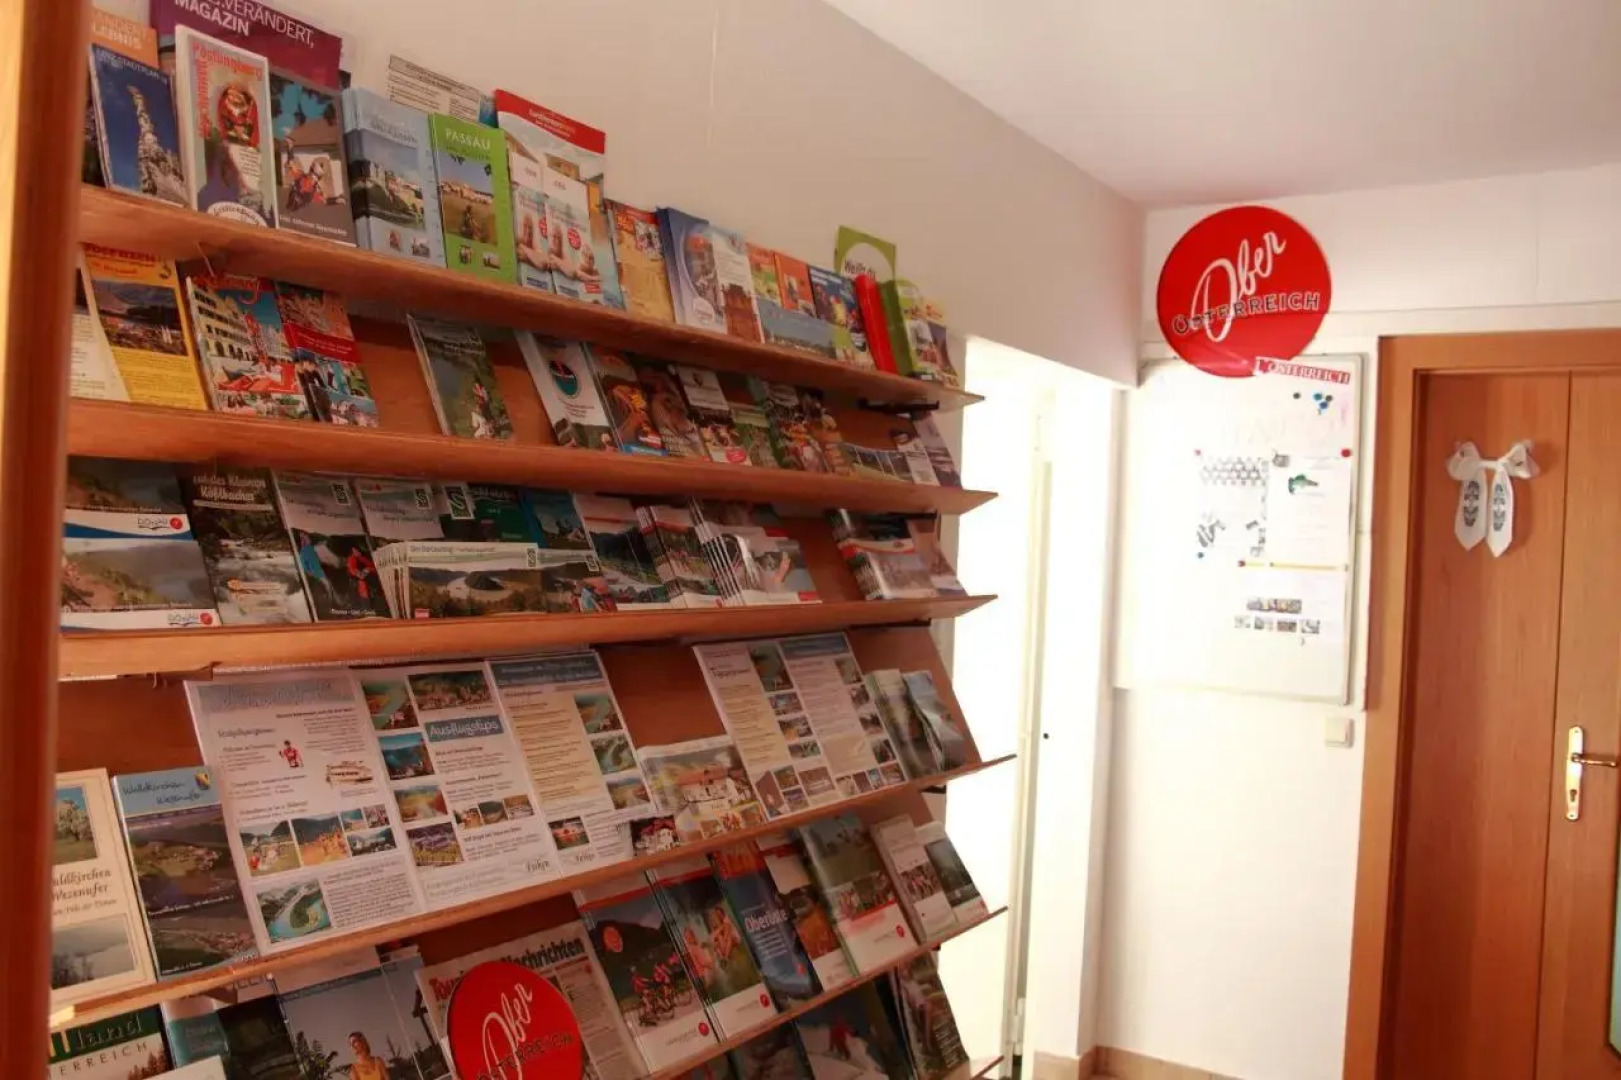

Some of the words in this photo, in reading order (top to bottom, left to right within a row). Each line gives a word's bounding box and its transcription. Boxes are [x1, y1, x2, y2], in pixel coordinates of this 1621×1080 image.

[175, 0, 249, 36] MAGAZIN
[445, 128, 491, 150] PASSAU
[1190, 230, 1287, 343] Ober
[1171, 291, 1321, 335] ÖSTERREICH
[51, 867, 112, 886] aldkirchen
[482, 982, 533, 1080] Ober
